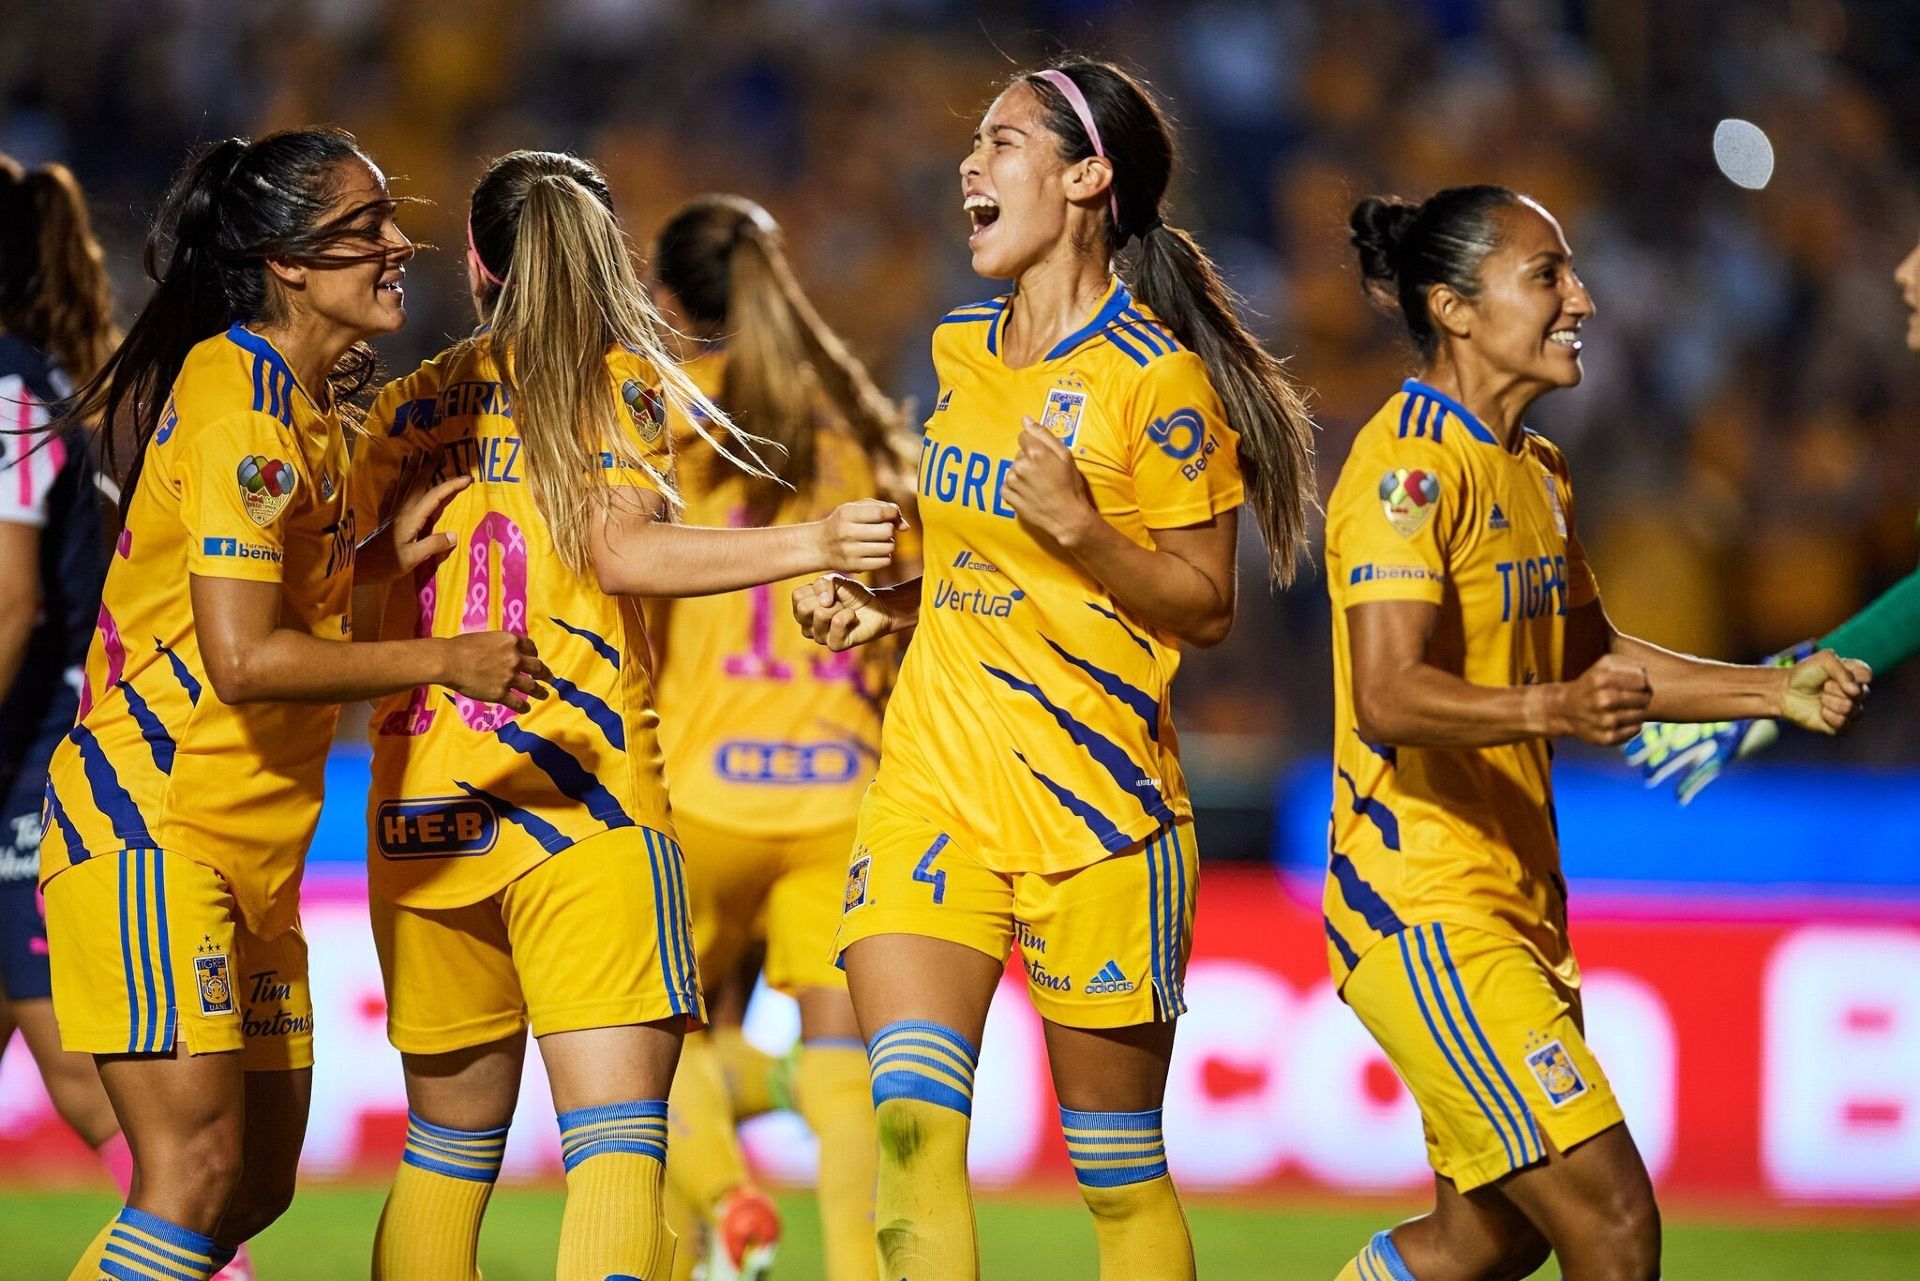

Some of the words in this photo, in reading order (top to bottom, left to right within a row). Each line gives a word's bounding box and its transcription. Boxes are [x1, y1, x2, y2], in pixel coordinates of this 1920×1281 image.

[1181, 433, 1220, 482] Berel
[917, 436, 1016, 519] TIGRE
[1376, 566, 1446, 583] benav
[1495, 555, 1567, 622] TIGRE
[934, 579, 1012, 618] Vertua
[912, 832, 950, 905] 4
[1014, 919, 1046, 954] Tim
[196, 957, 227, 971] TIGRES
[1024, 959, 1071, 991] tons
[249, 970, 292, 1004] Tim
[1085, 981, 1134, 994] adidas
